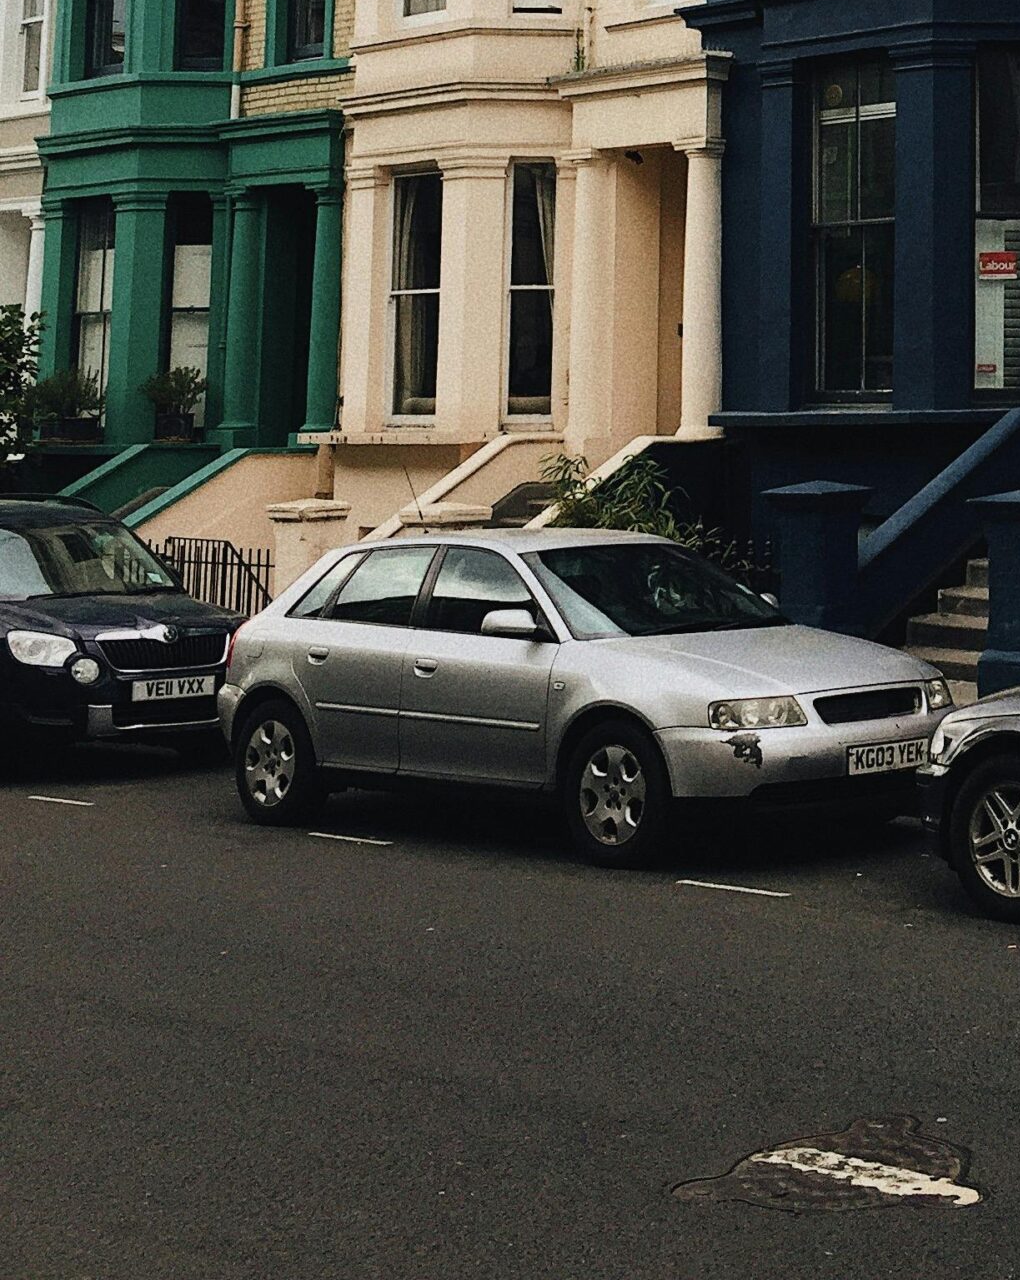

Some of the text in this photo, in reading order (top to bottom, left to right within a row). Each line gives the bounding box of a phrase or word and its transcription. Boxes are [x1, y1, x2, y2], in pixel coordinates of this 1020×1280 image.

[979, 260, 1016, 270] Labour
[146, 678, 205, 697] VE11 VXX
[855, 741, 924, 770] KG03 YEK
